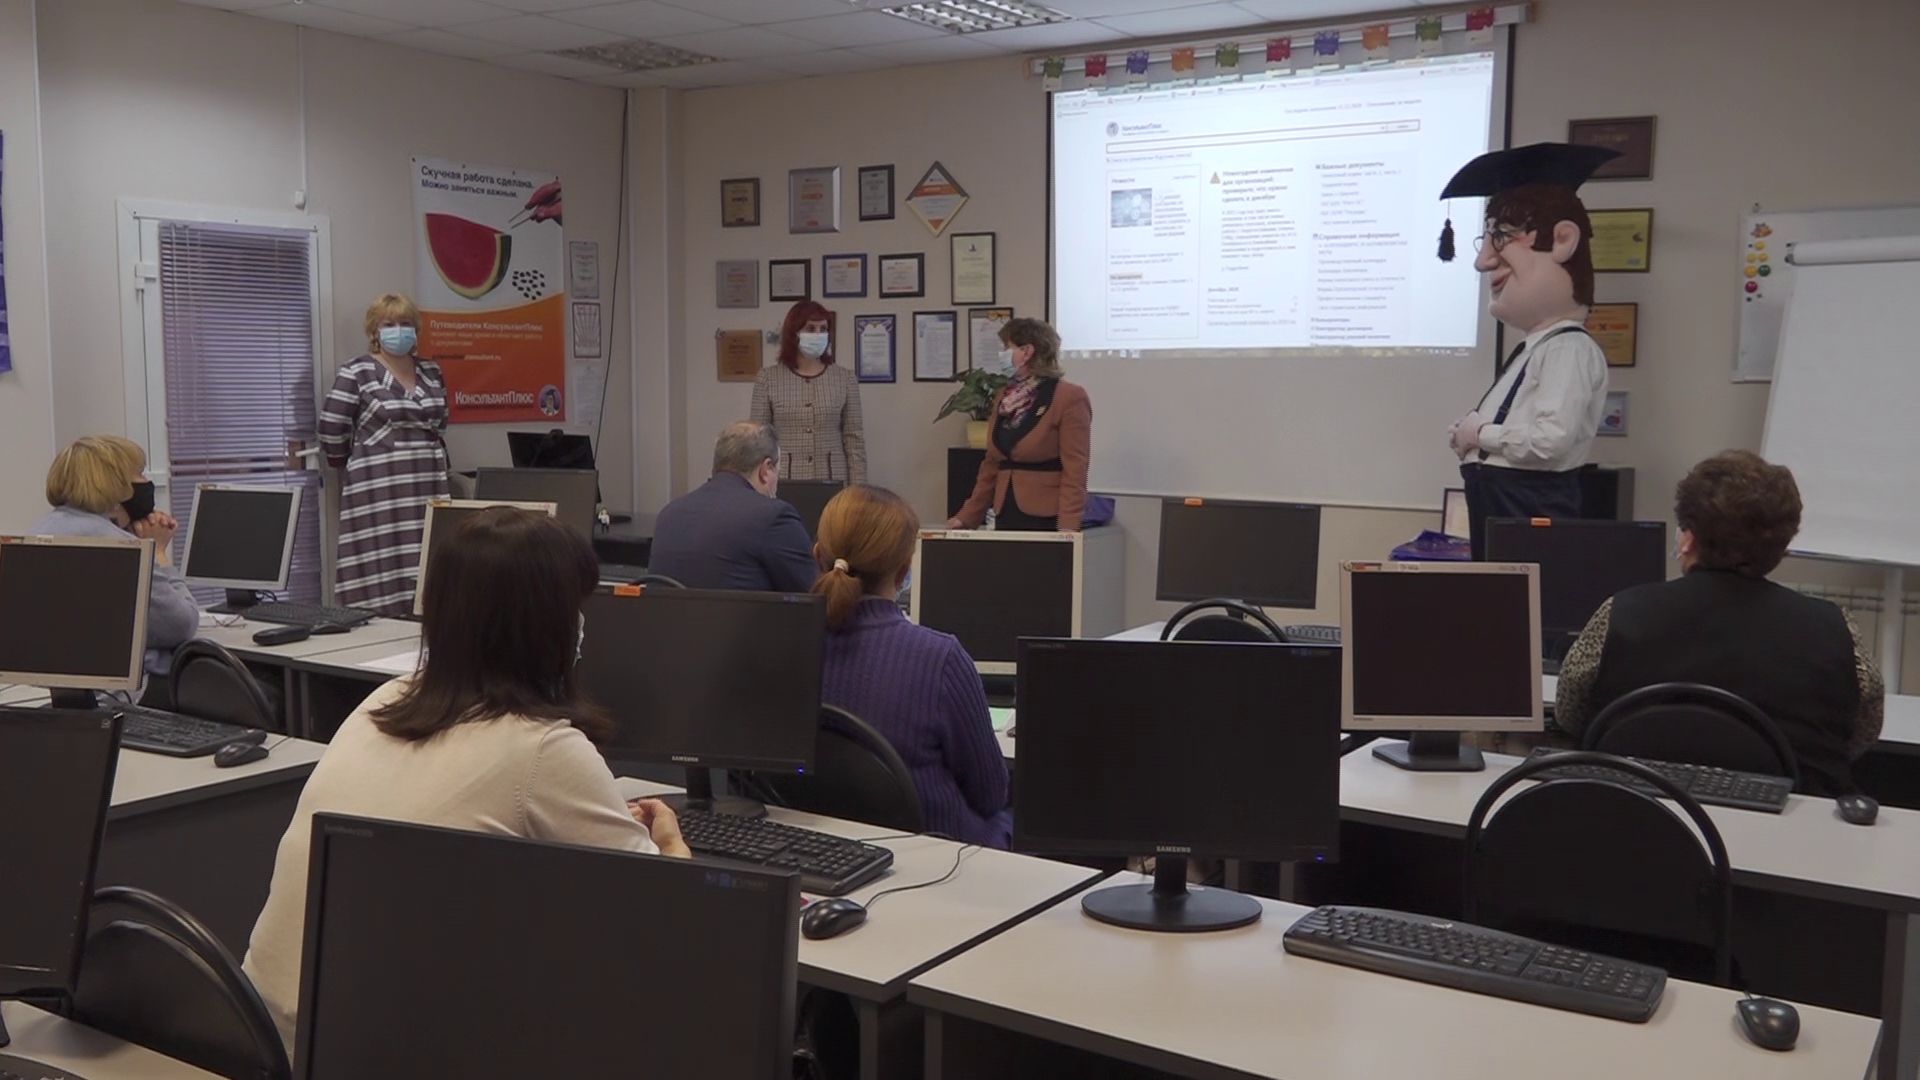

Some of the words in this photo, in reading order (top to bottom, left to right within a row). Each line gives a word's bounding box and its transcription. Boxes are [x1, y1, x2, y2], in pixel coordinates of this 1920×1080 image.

[1348, 161, 1385, 170] документы
[421, 165, 461, 179] Скучная
[463, 172, 495, 184] работа
[421, 179, 449, 191] Можно
[451, 183, 485, 195] заняться
[1358, 231, 1400, 240] информация
[430, 319, 482, 331] Путеводители
[483, 321, 544, 333] КонсультантПлюс
[1156, 845, 1191, 853] SAMSUNG
